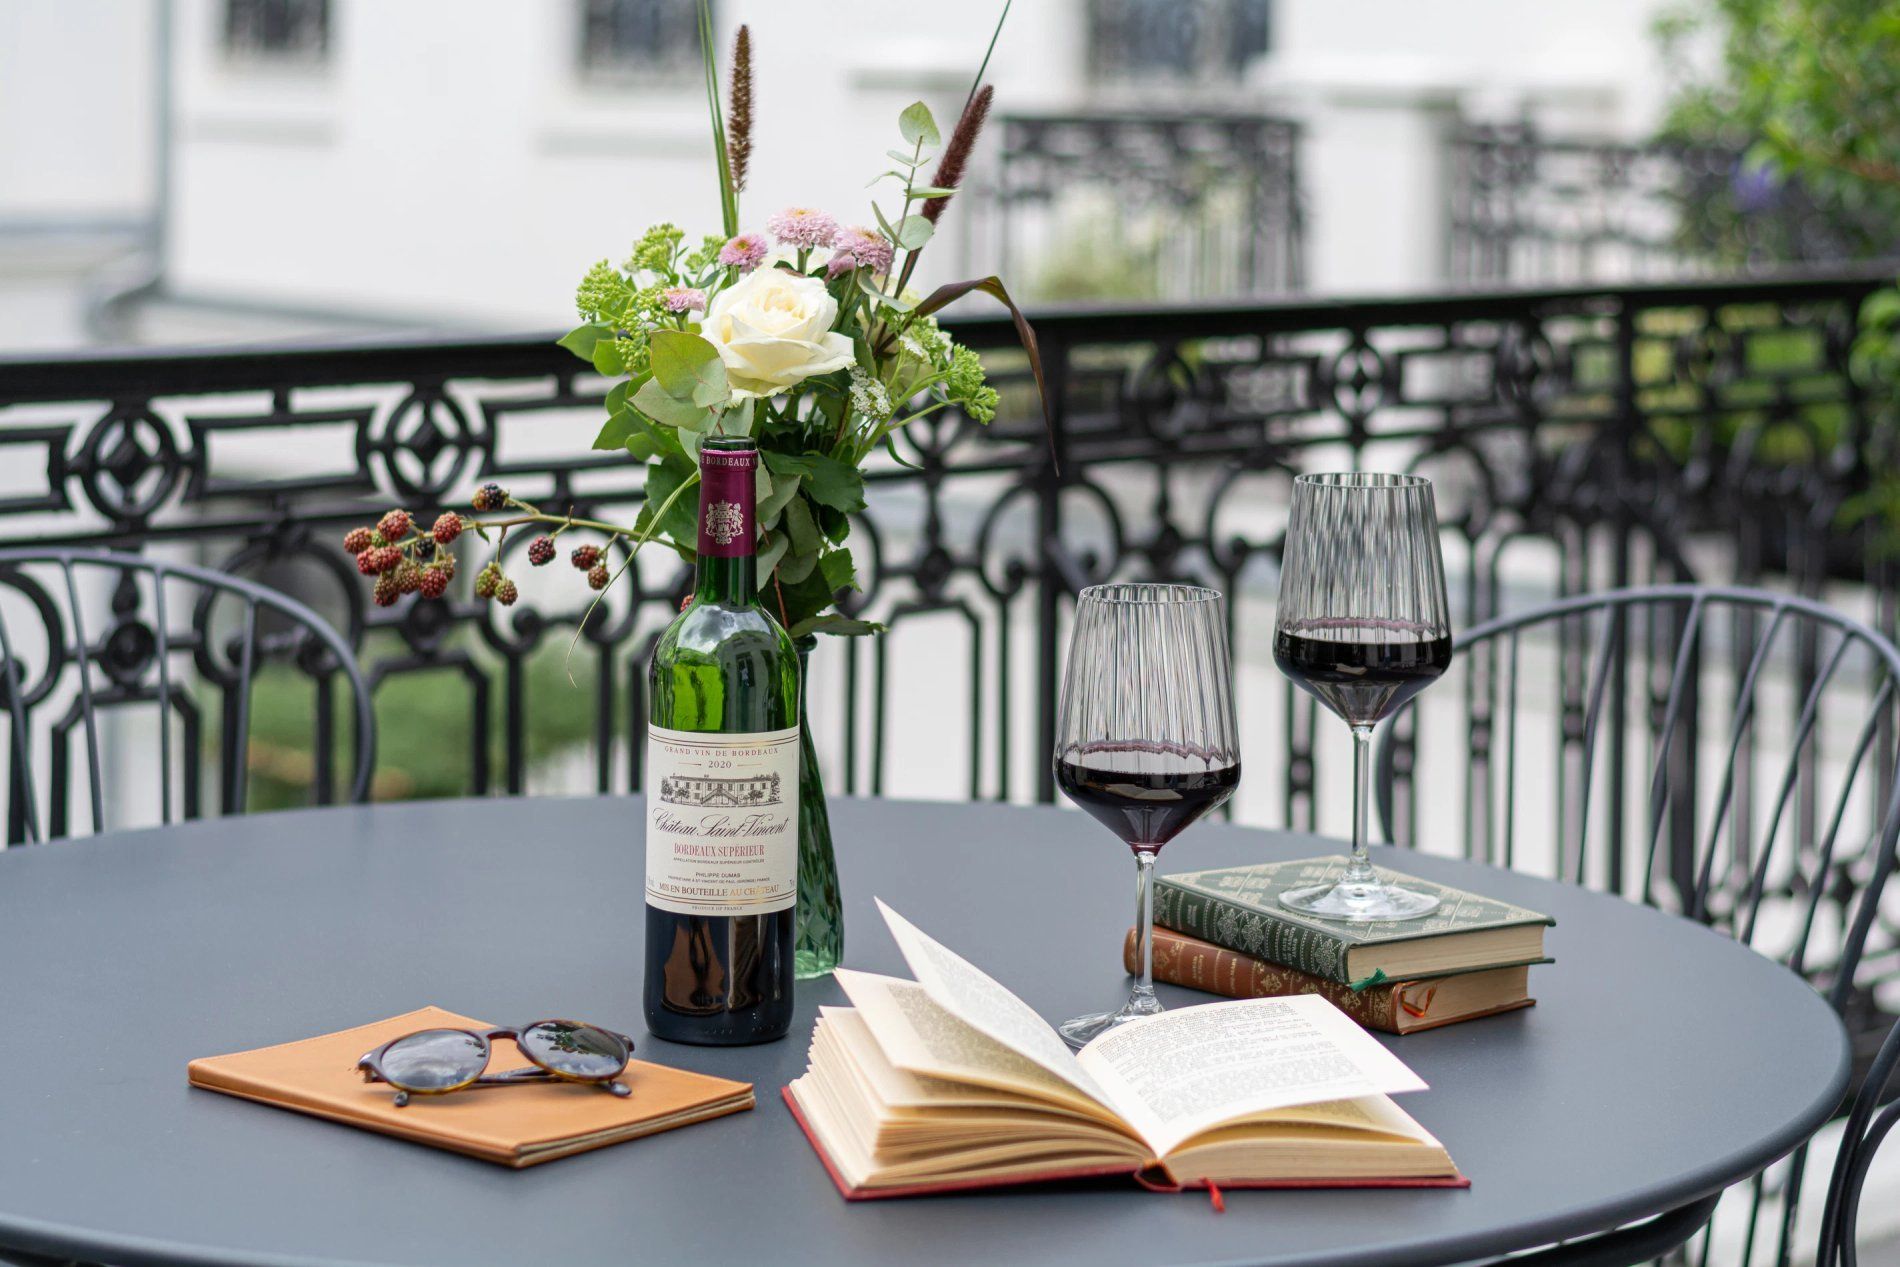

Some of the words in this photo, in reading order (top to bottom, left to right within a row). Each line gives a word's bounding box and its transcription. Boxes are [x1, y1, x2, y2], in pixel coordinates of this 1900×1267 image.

[706, 456, 750, 467] BORDEAUX
[664, 746, 691, 755] GRAND
[732, 747, 779, 757] BORDEAUX
[708, 760, 732, 769] 2020
[652, 807, 697, 835] Château
[674, 842, 716, 857] BORDEAUX
[659, 883, 670, 892] MIS
[670, 885, 680, 893] EN
[681, 887, 729, 897] BOUTEILLE
[729, 889, 742, 897] AU
